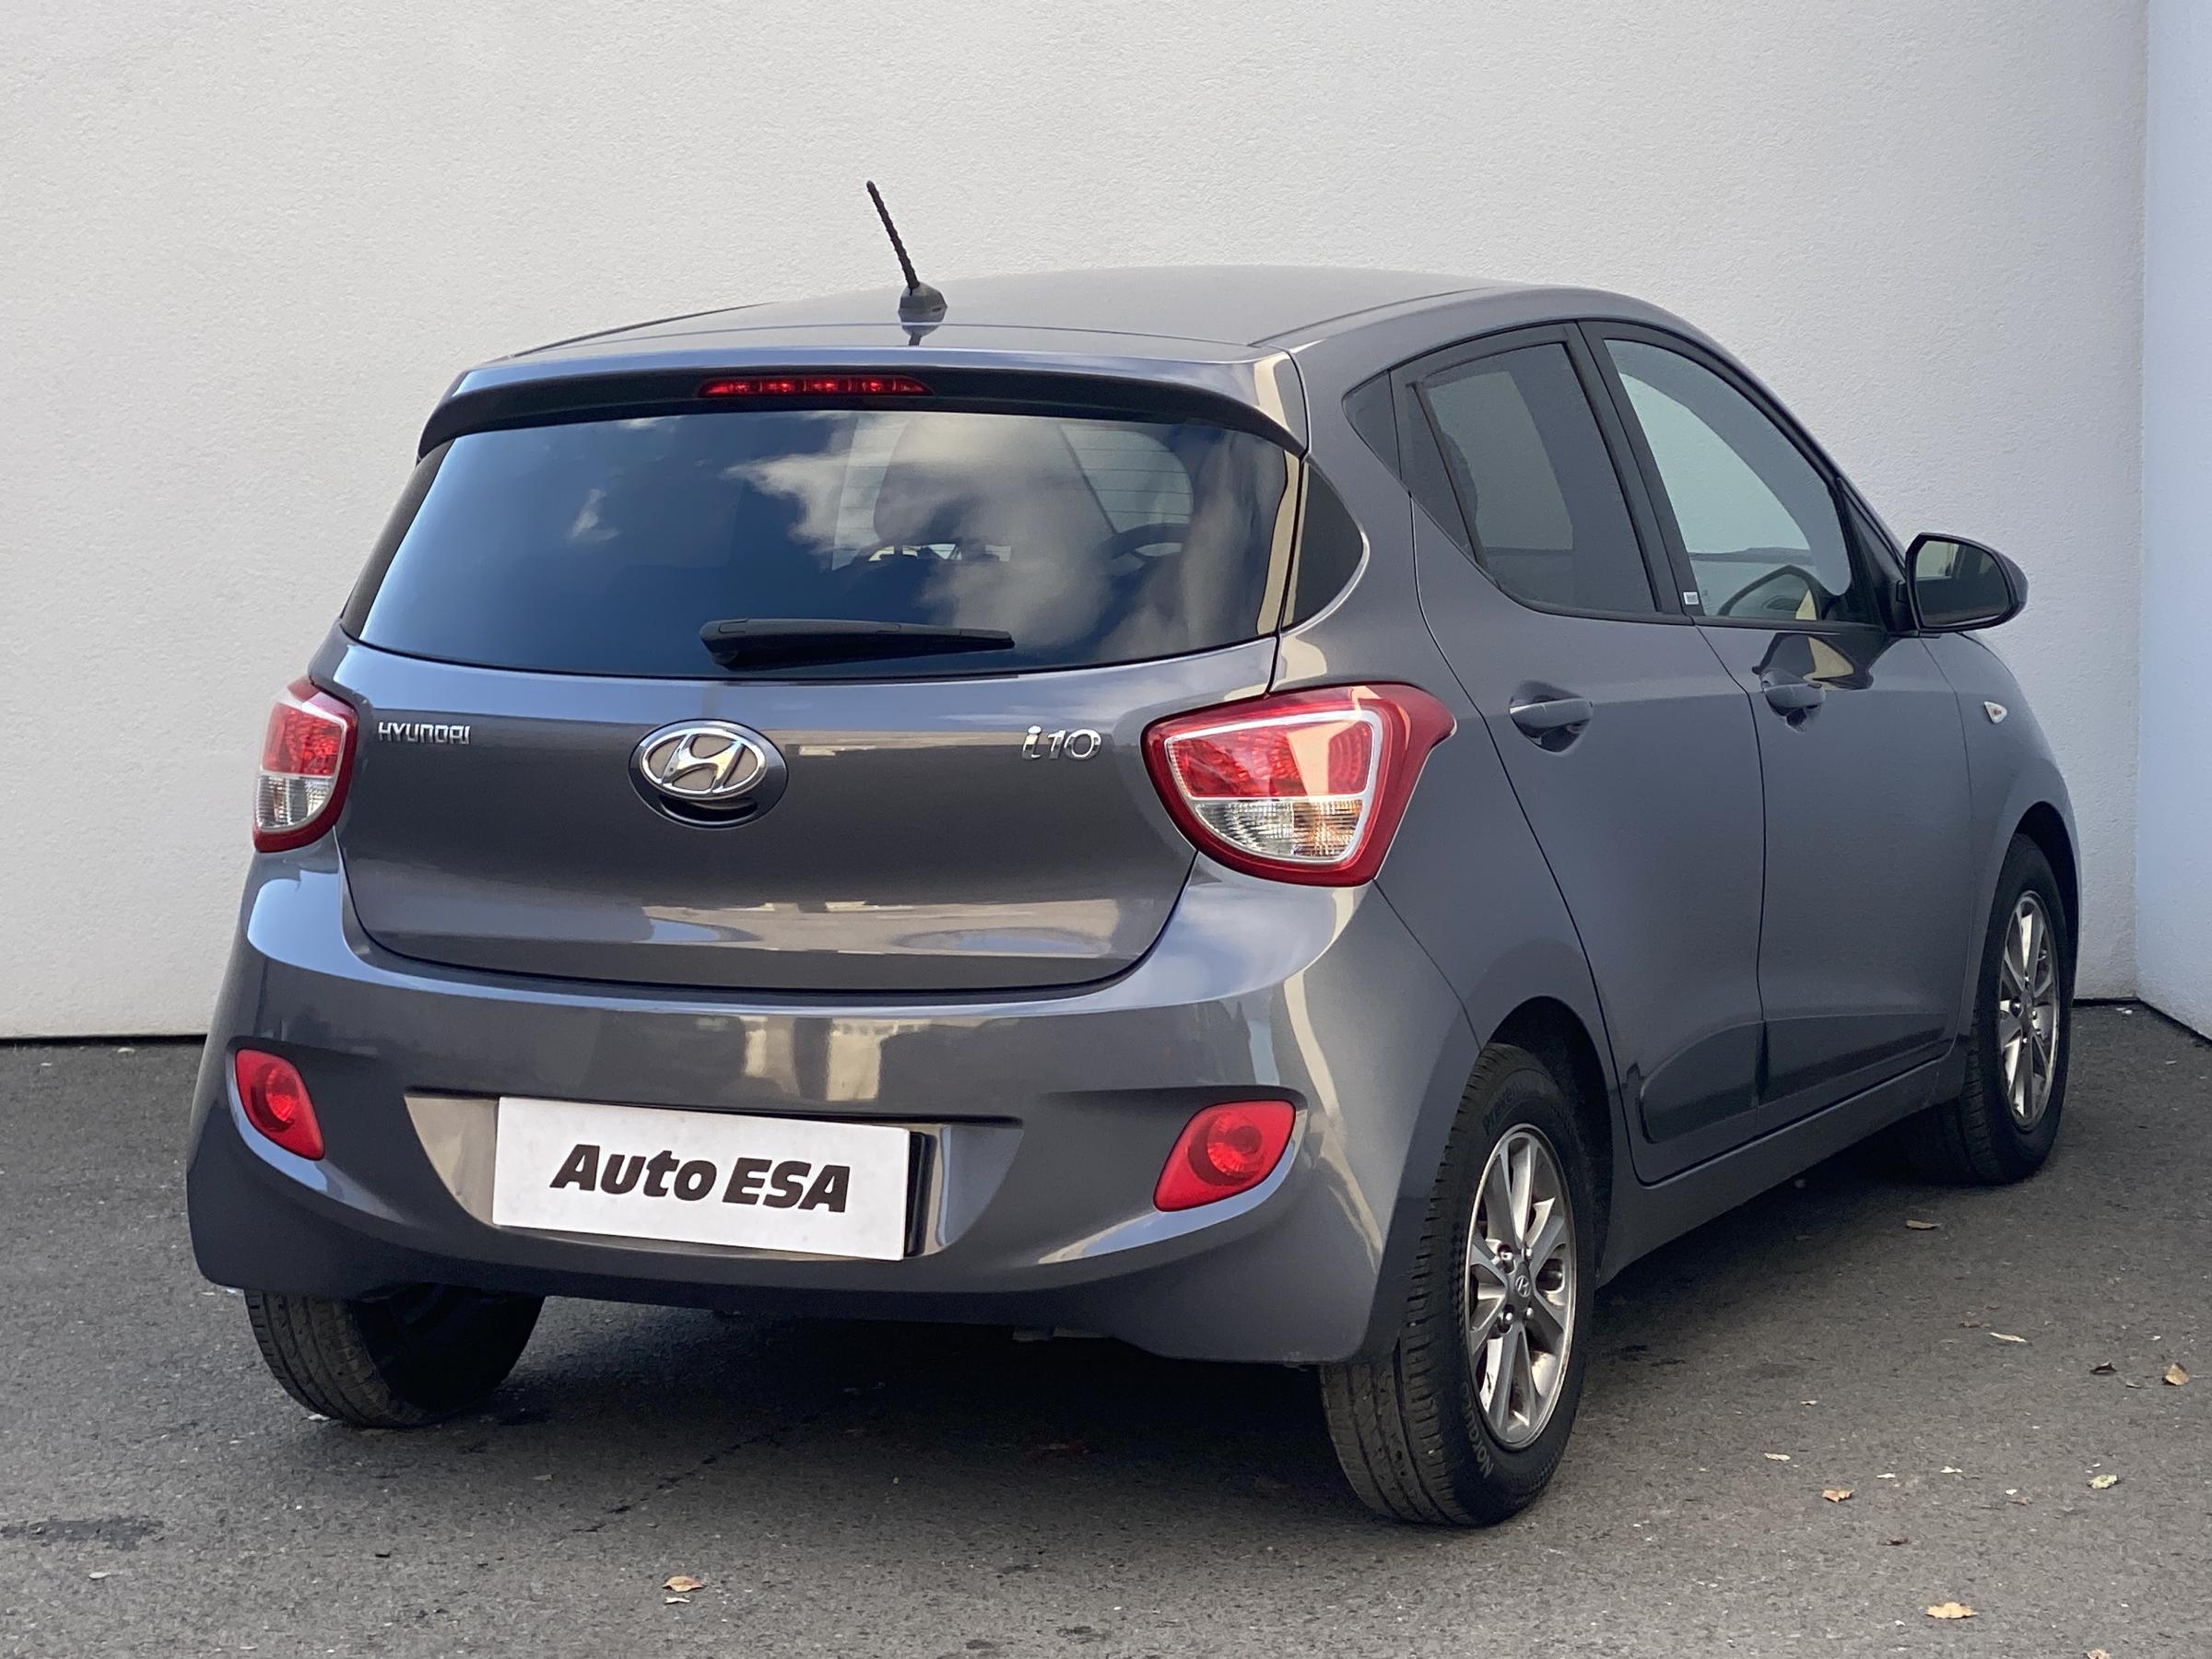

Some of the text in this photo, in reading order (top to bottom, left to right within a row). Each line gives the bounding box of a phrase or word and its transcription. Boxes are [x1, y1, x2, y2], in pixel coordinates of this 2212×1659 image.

[378, 722, 471, 745] HYUNDAI
[1021, 724, 1101, 760] i10
[549, 1144, 851, 1213] Auto ESA
